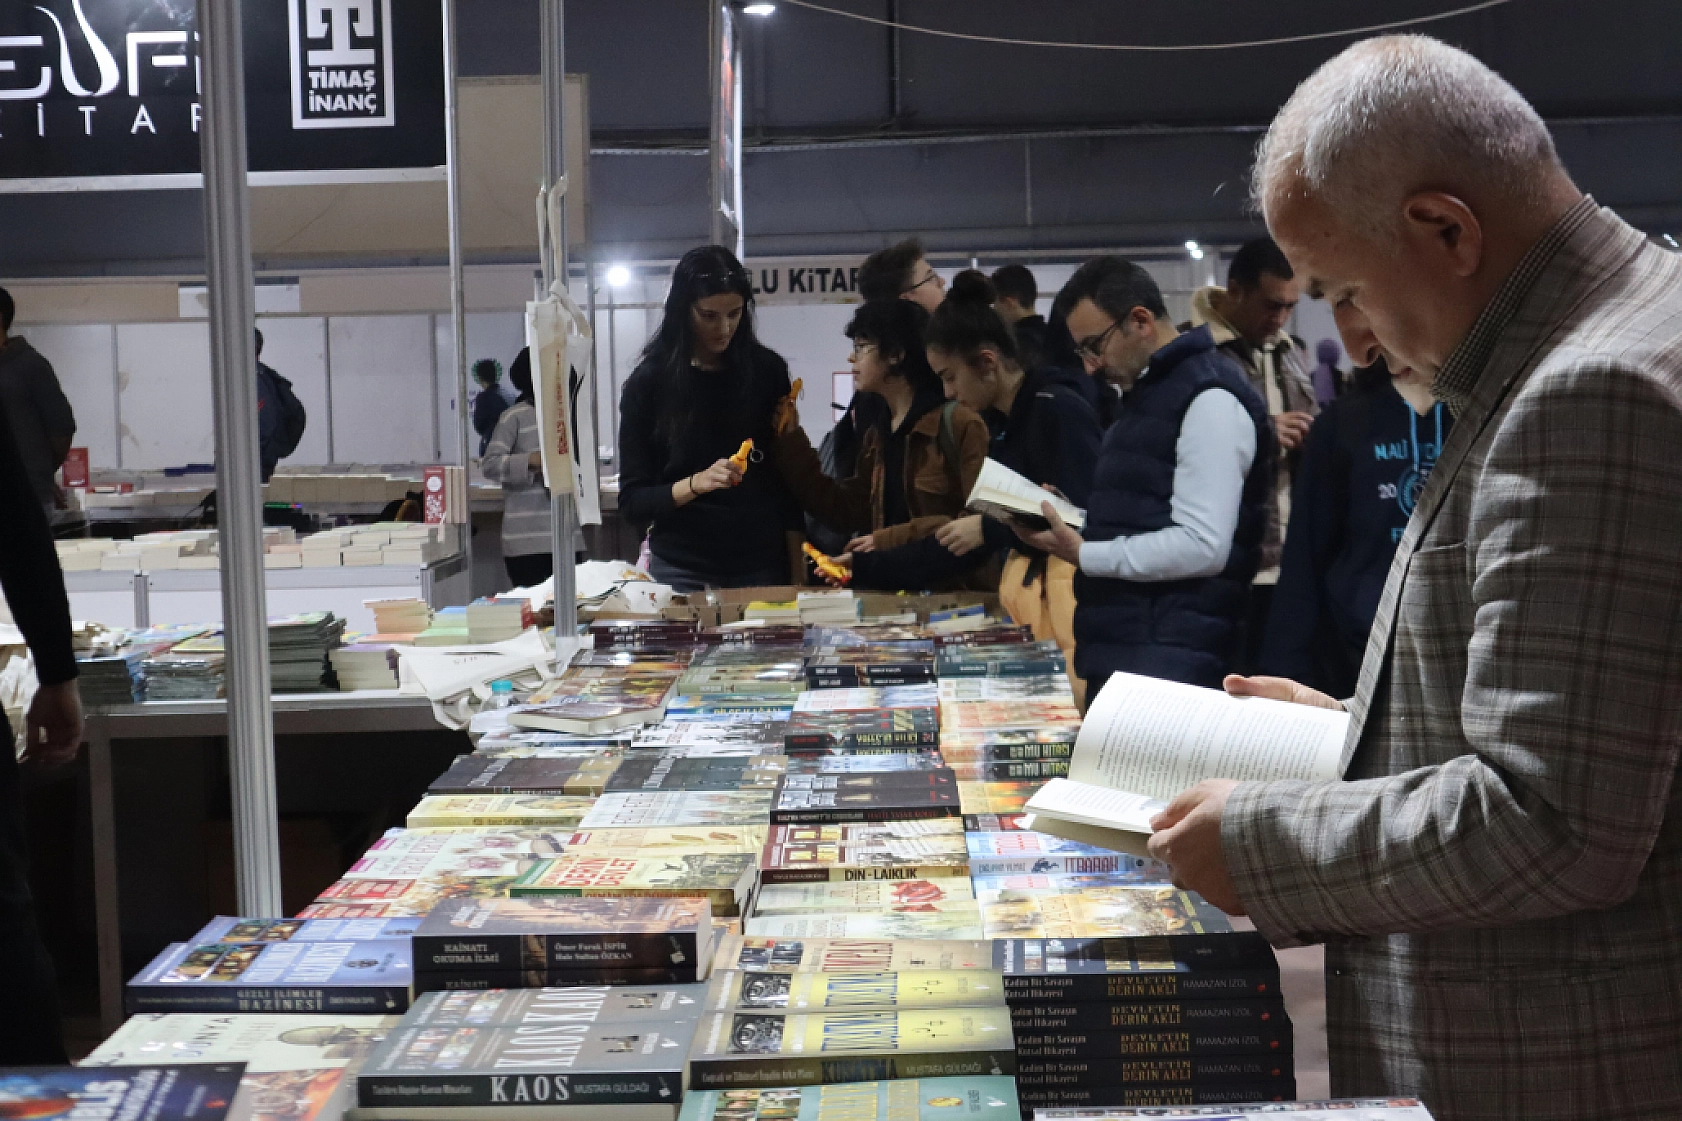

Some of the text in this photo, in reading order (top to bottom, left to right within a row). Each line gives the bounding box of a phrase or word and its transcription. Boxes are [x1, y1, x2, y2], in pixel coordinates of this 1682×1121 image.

[308, 67, 377, 92] TİMAŞ
[308, 90, 377, 114] İNANÇ
[489, 1076, 570, 1102] KAOS
